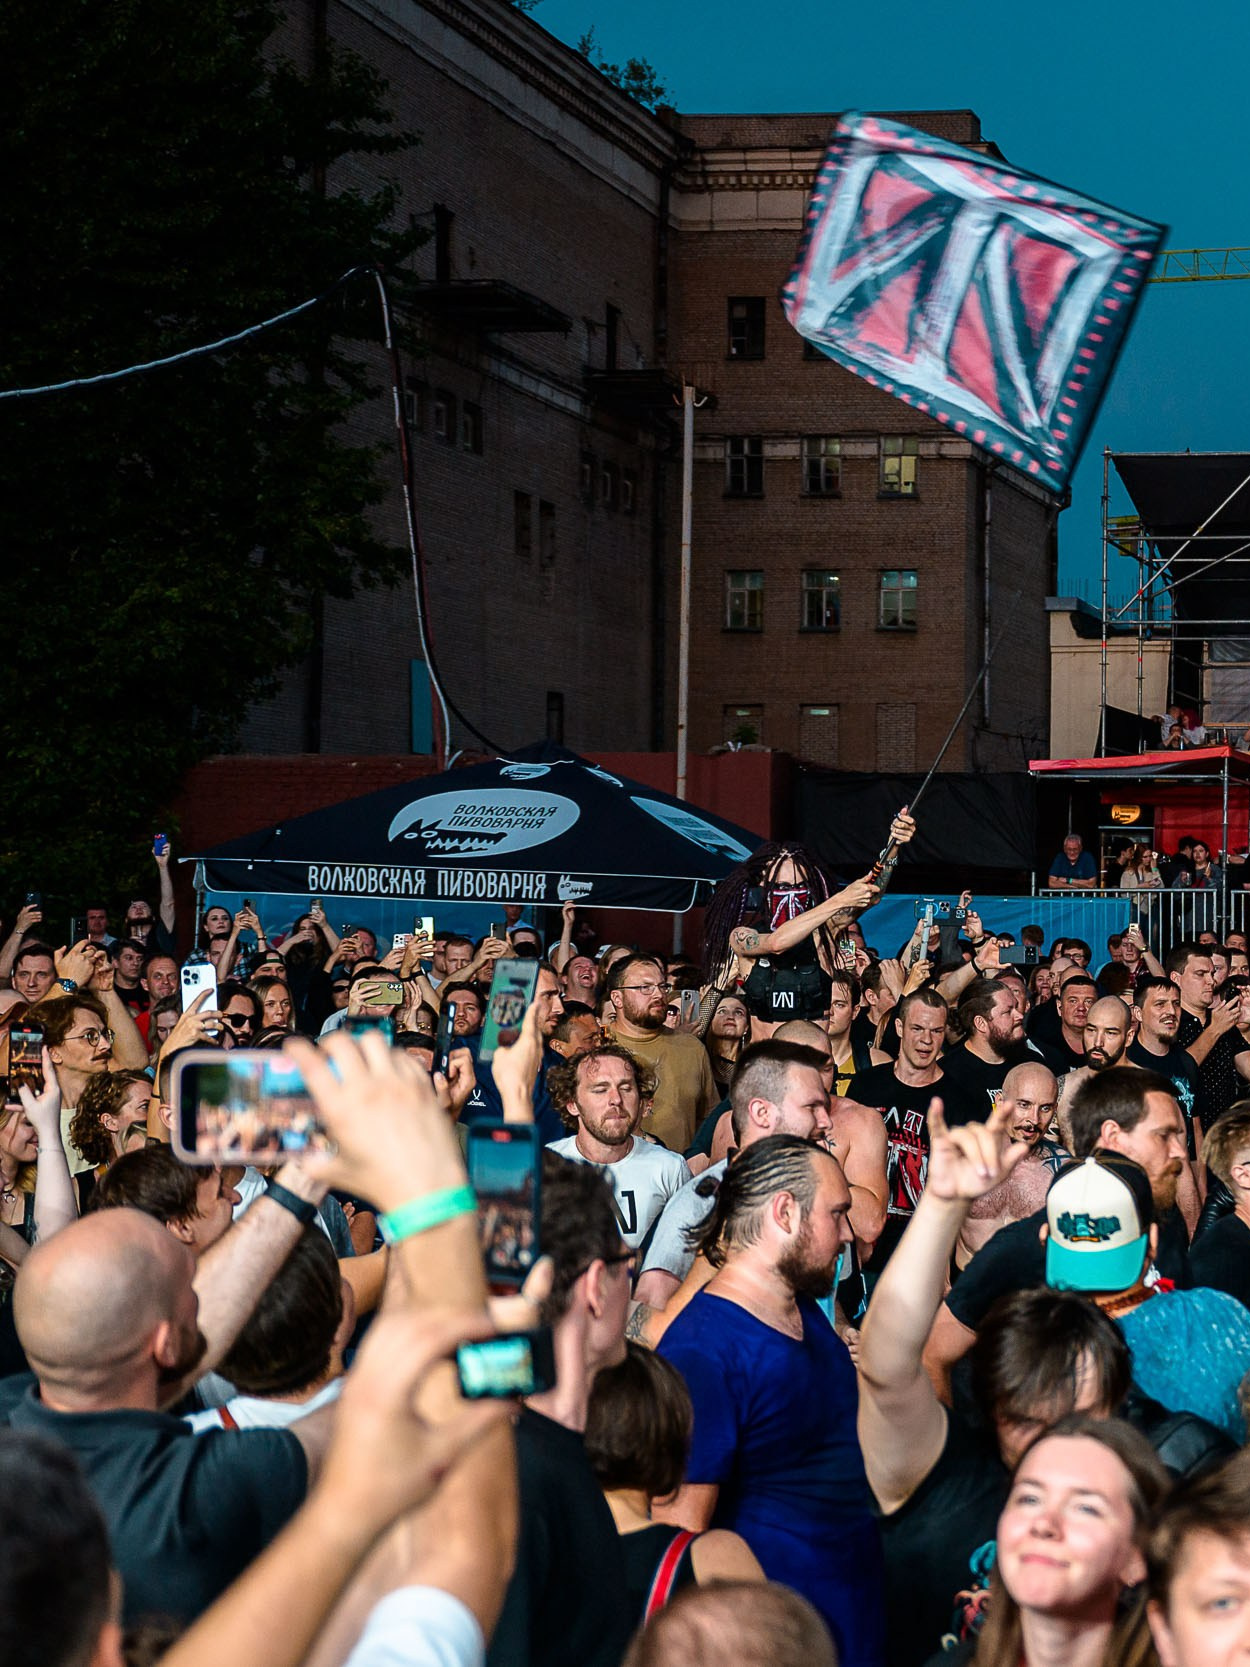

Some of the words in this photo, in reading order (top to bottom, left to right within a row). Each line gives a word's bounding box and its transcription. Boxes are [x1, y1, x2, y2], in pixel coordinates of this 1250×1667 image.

[453, 803, 558, 817] ВОЛКОВСКАЯ
[447, 815, 546, 829] ПИВОВАРНЯ
[308, 865, 426, 895] ВОЛКОВСКАЯ
[437, 869, 547, 899] ПИВОВАРНЯ
